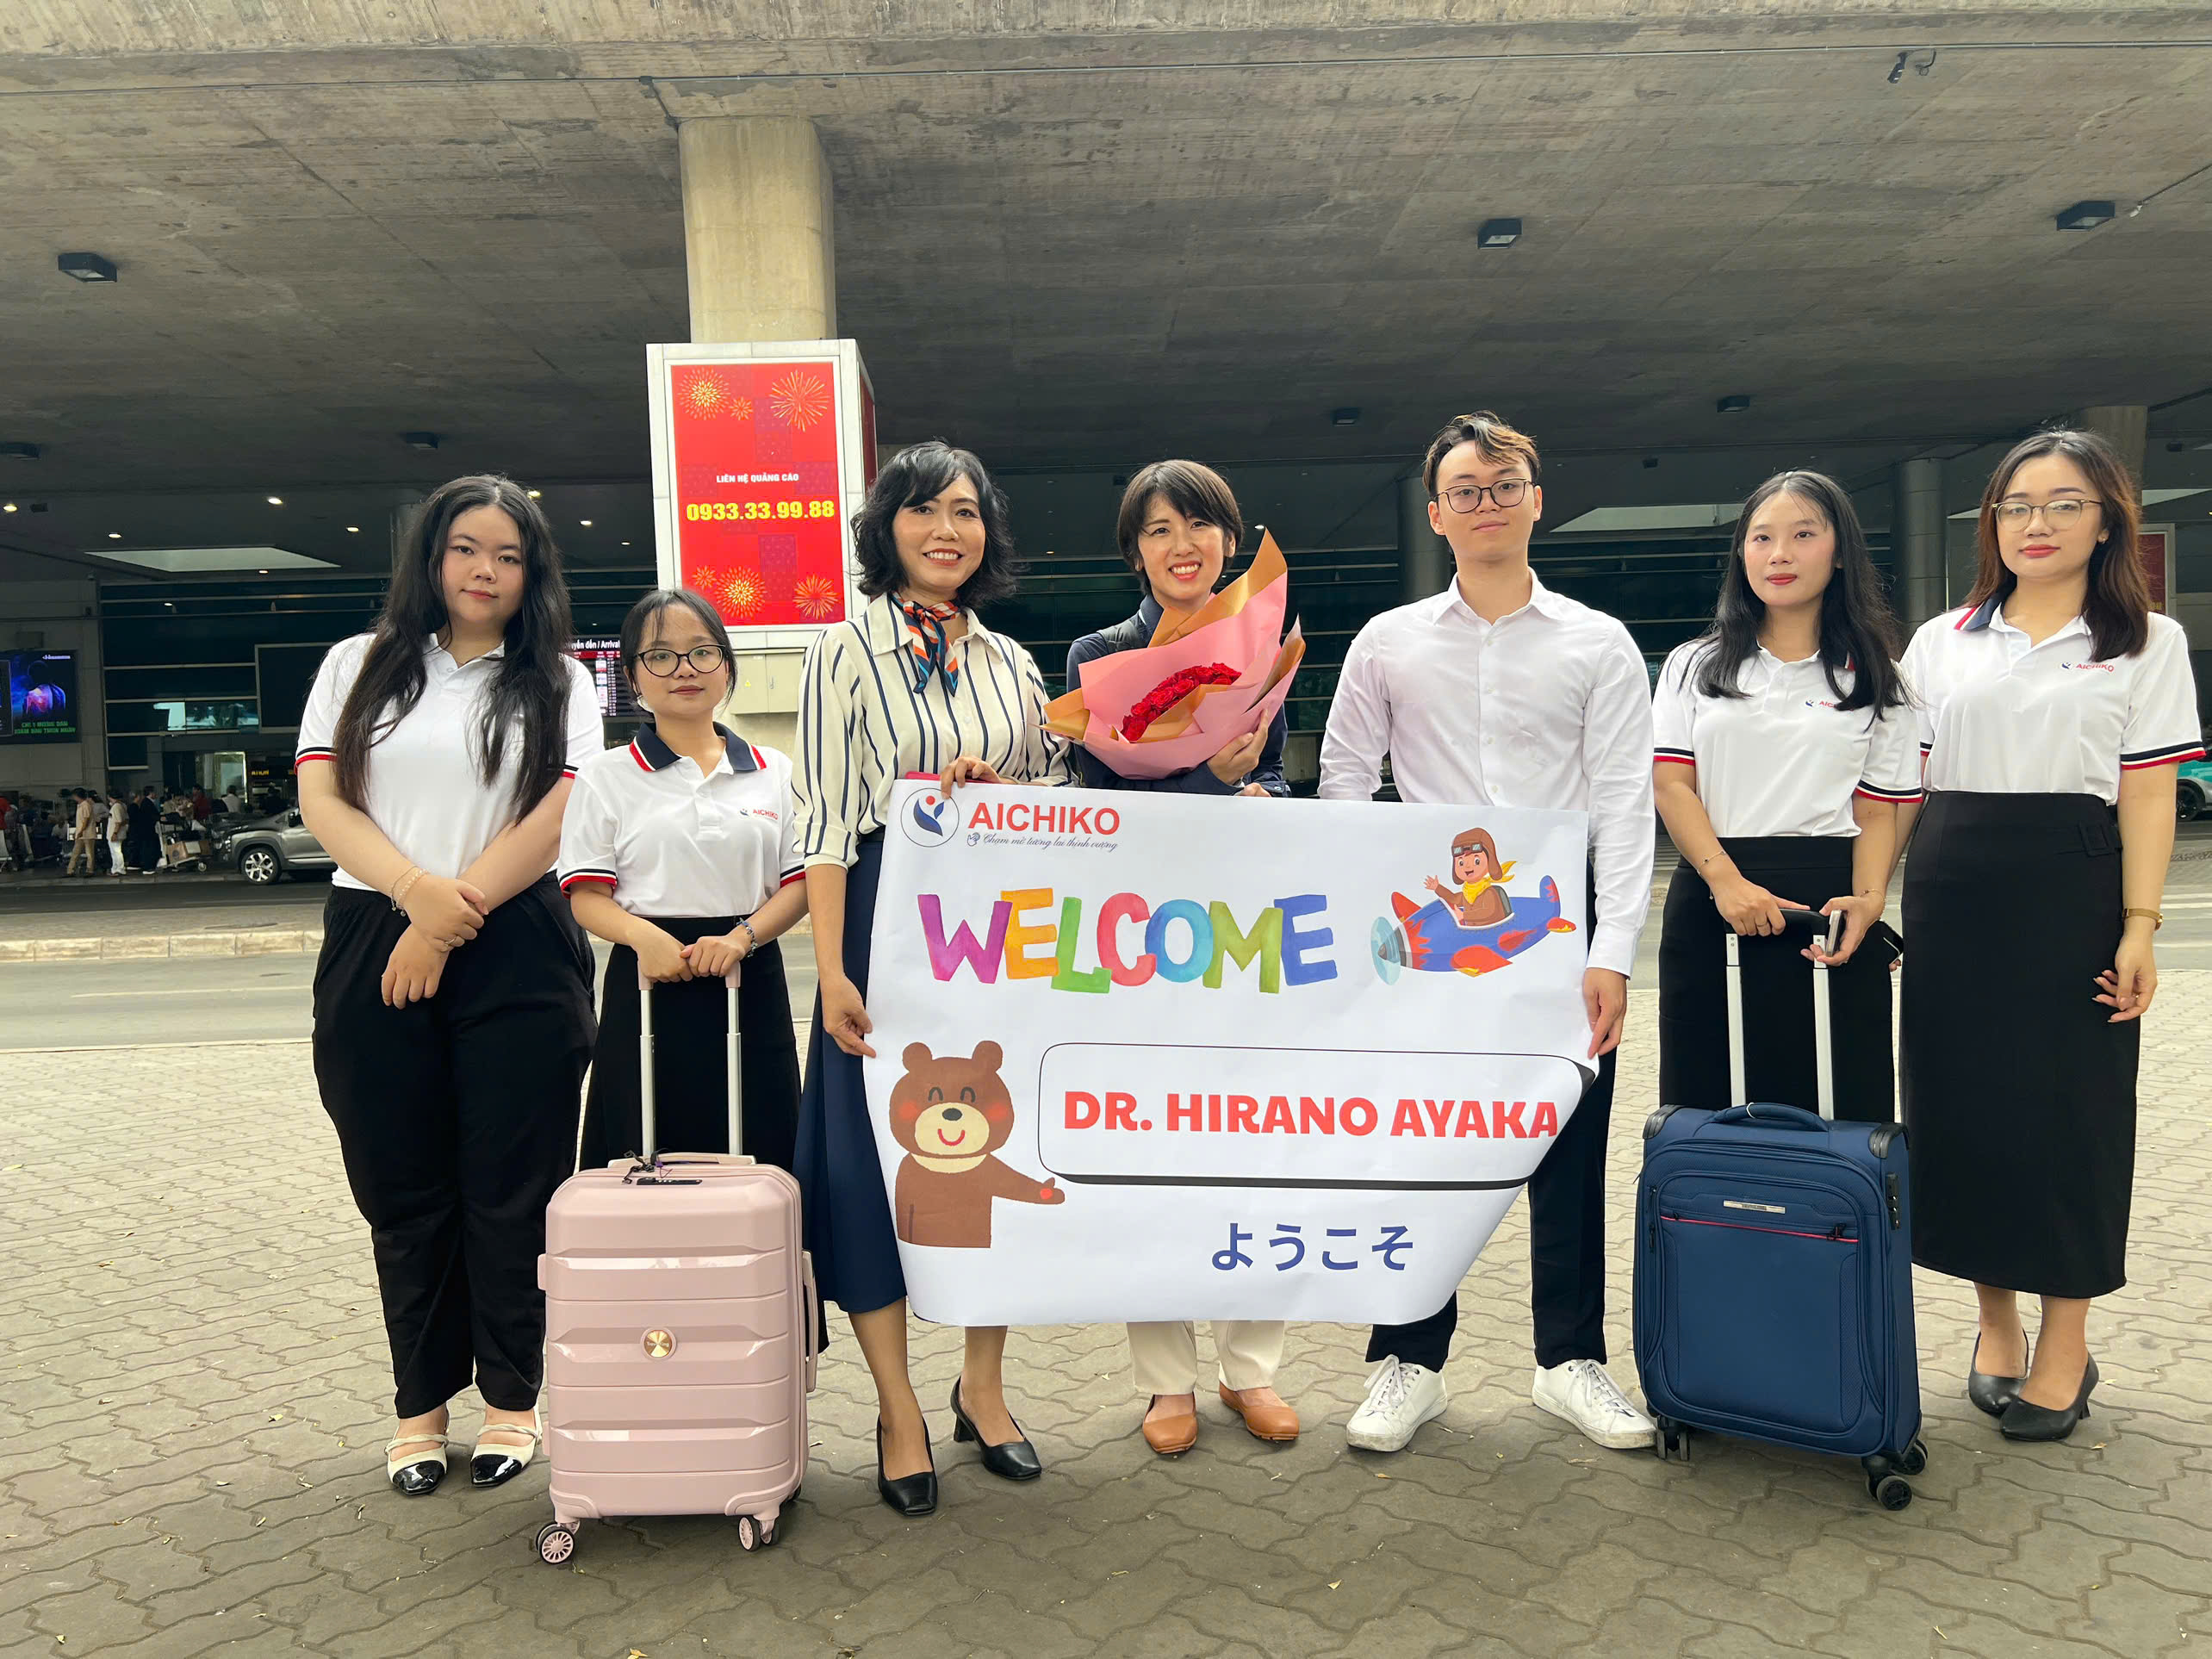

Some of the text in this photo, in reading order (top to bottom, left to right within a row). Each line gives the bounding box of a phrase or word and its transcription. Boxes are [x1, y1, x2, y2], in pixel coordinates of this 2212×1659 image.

[716, 471, 799, 485] LIÊN HỆ QUẢNG CÁO
[687, 500, 835, 521] 0933.33.99.88
[2076, 663, 2115, 673] AICHIKO
[752, 809, 779, 821] AICHIKO
[968, 802, 1121, 836] AICHIKO
[983, 833, 1010, 845] Chạm
[1053, 836, 1066, 847] lai
[1066, 836, 1090, 848] thịnh
[1090, 841, 1119, 853] vượng
[918, 888, 1338, 994] WELCOME
[1065, 1091, 1557, 1139] DR. HIRANO AYAKA
[1212, 1222, 1414, 1271] ようこそ
